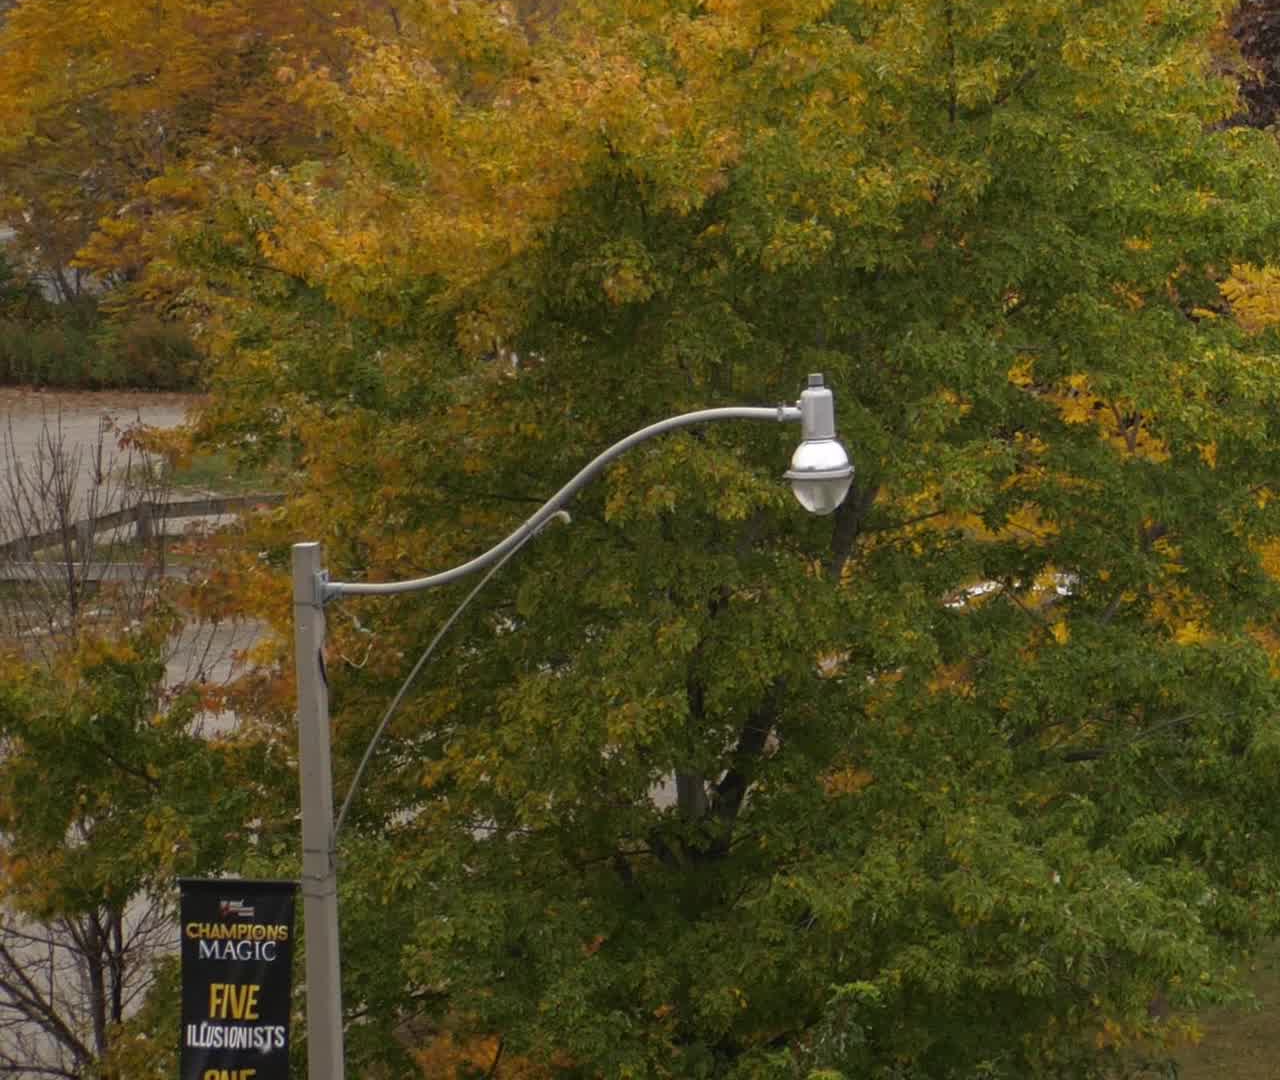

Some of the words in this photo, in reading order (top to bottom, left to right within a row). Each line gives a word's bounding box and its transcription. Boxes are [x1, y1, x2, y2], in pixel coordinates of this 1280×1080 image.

[186, 922, 289, 941] CHAMPIONS
[199, 939, 277, 961] MAGIC
[209, 983, 260, 1020] FIVE
[186, 1022, 286, 1053] ILLUSIONISTS
